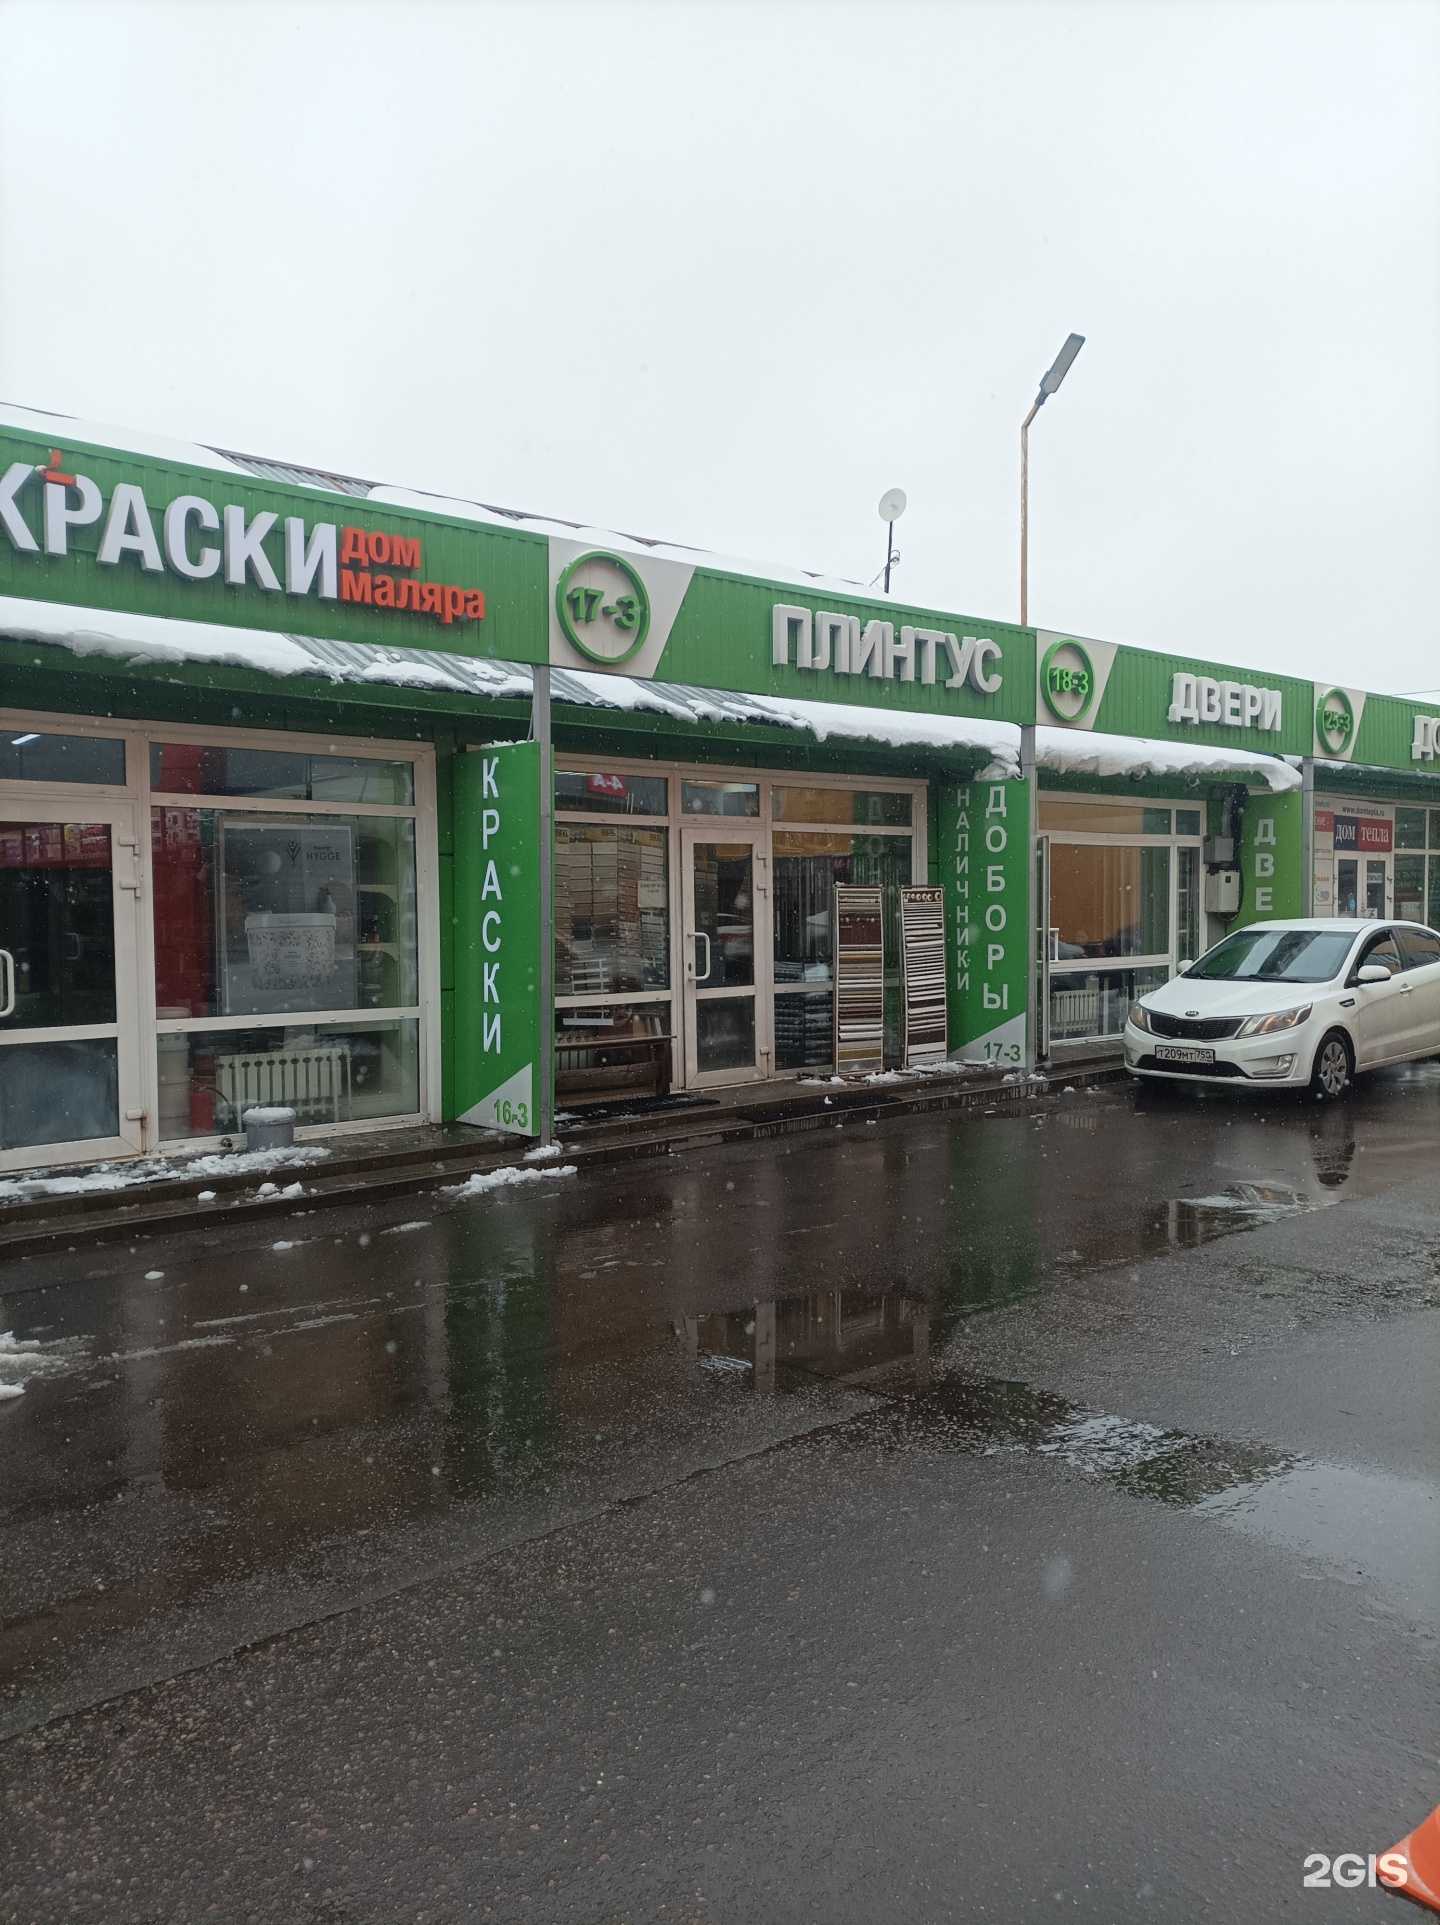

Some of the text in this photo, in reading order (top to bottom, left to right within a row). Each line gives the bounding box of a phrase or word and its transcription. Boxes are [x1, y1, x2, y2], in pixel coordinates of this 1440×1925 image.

[0, 462, 338, 599] КРАСКИ
[567, 586, 643, 630] 17-3
[772, 603, 1003, 694] ПЛИНТУС
[1052, 667, 1089, 694] 18-3
[1168, 672, 1282, 732] ДВЕРИ
[481, 757, 502, 1054] КРАСКИ
[955, 787, 971, 992] НАЛИЧНИКИ
[983, 785, 1009, 1011] ДОБОРЫ
[983, 1041, 1021, 1062] 17-3
[493, 1100, 528, 1129] 16-3
